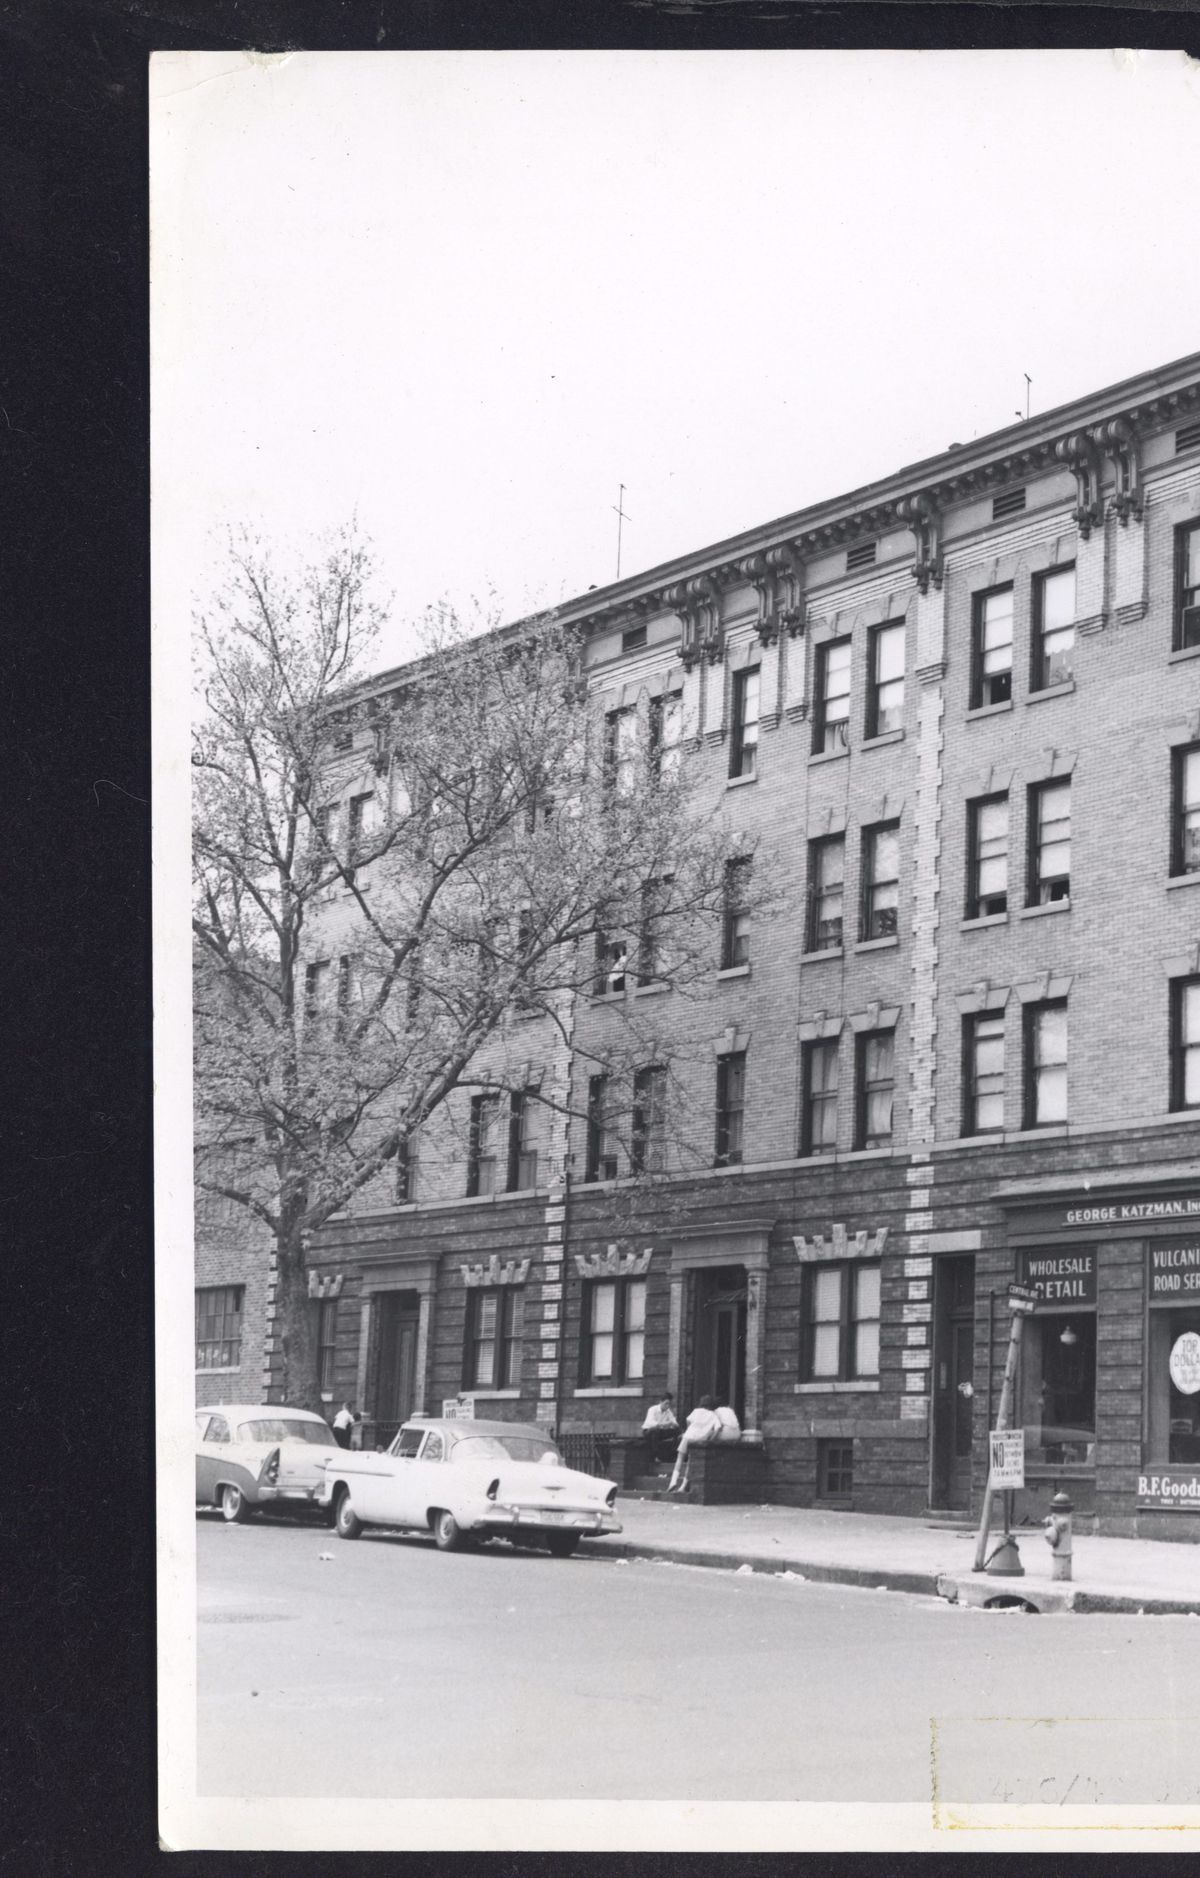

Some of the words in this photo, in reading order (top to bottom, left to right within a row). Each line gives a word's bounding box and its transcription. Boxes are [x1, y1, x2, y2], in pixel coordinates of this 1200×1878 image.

[1067, 1207, 1117, 1222] GEORGE
[1029, 1257, 1092, 1276] WHOLESALE
[1154, 1274, 1181, 1291] ROAD
[993, 1442, 1004, 1468] NO
